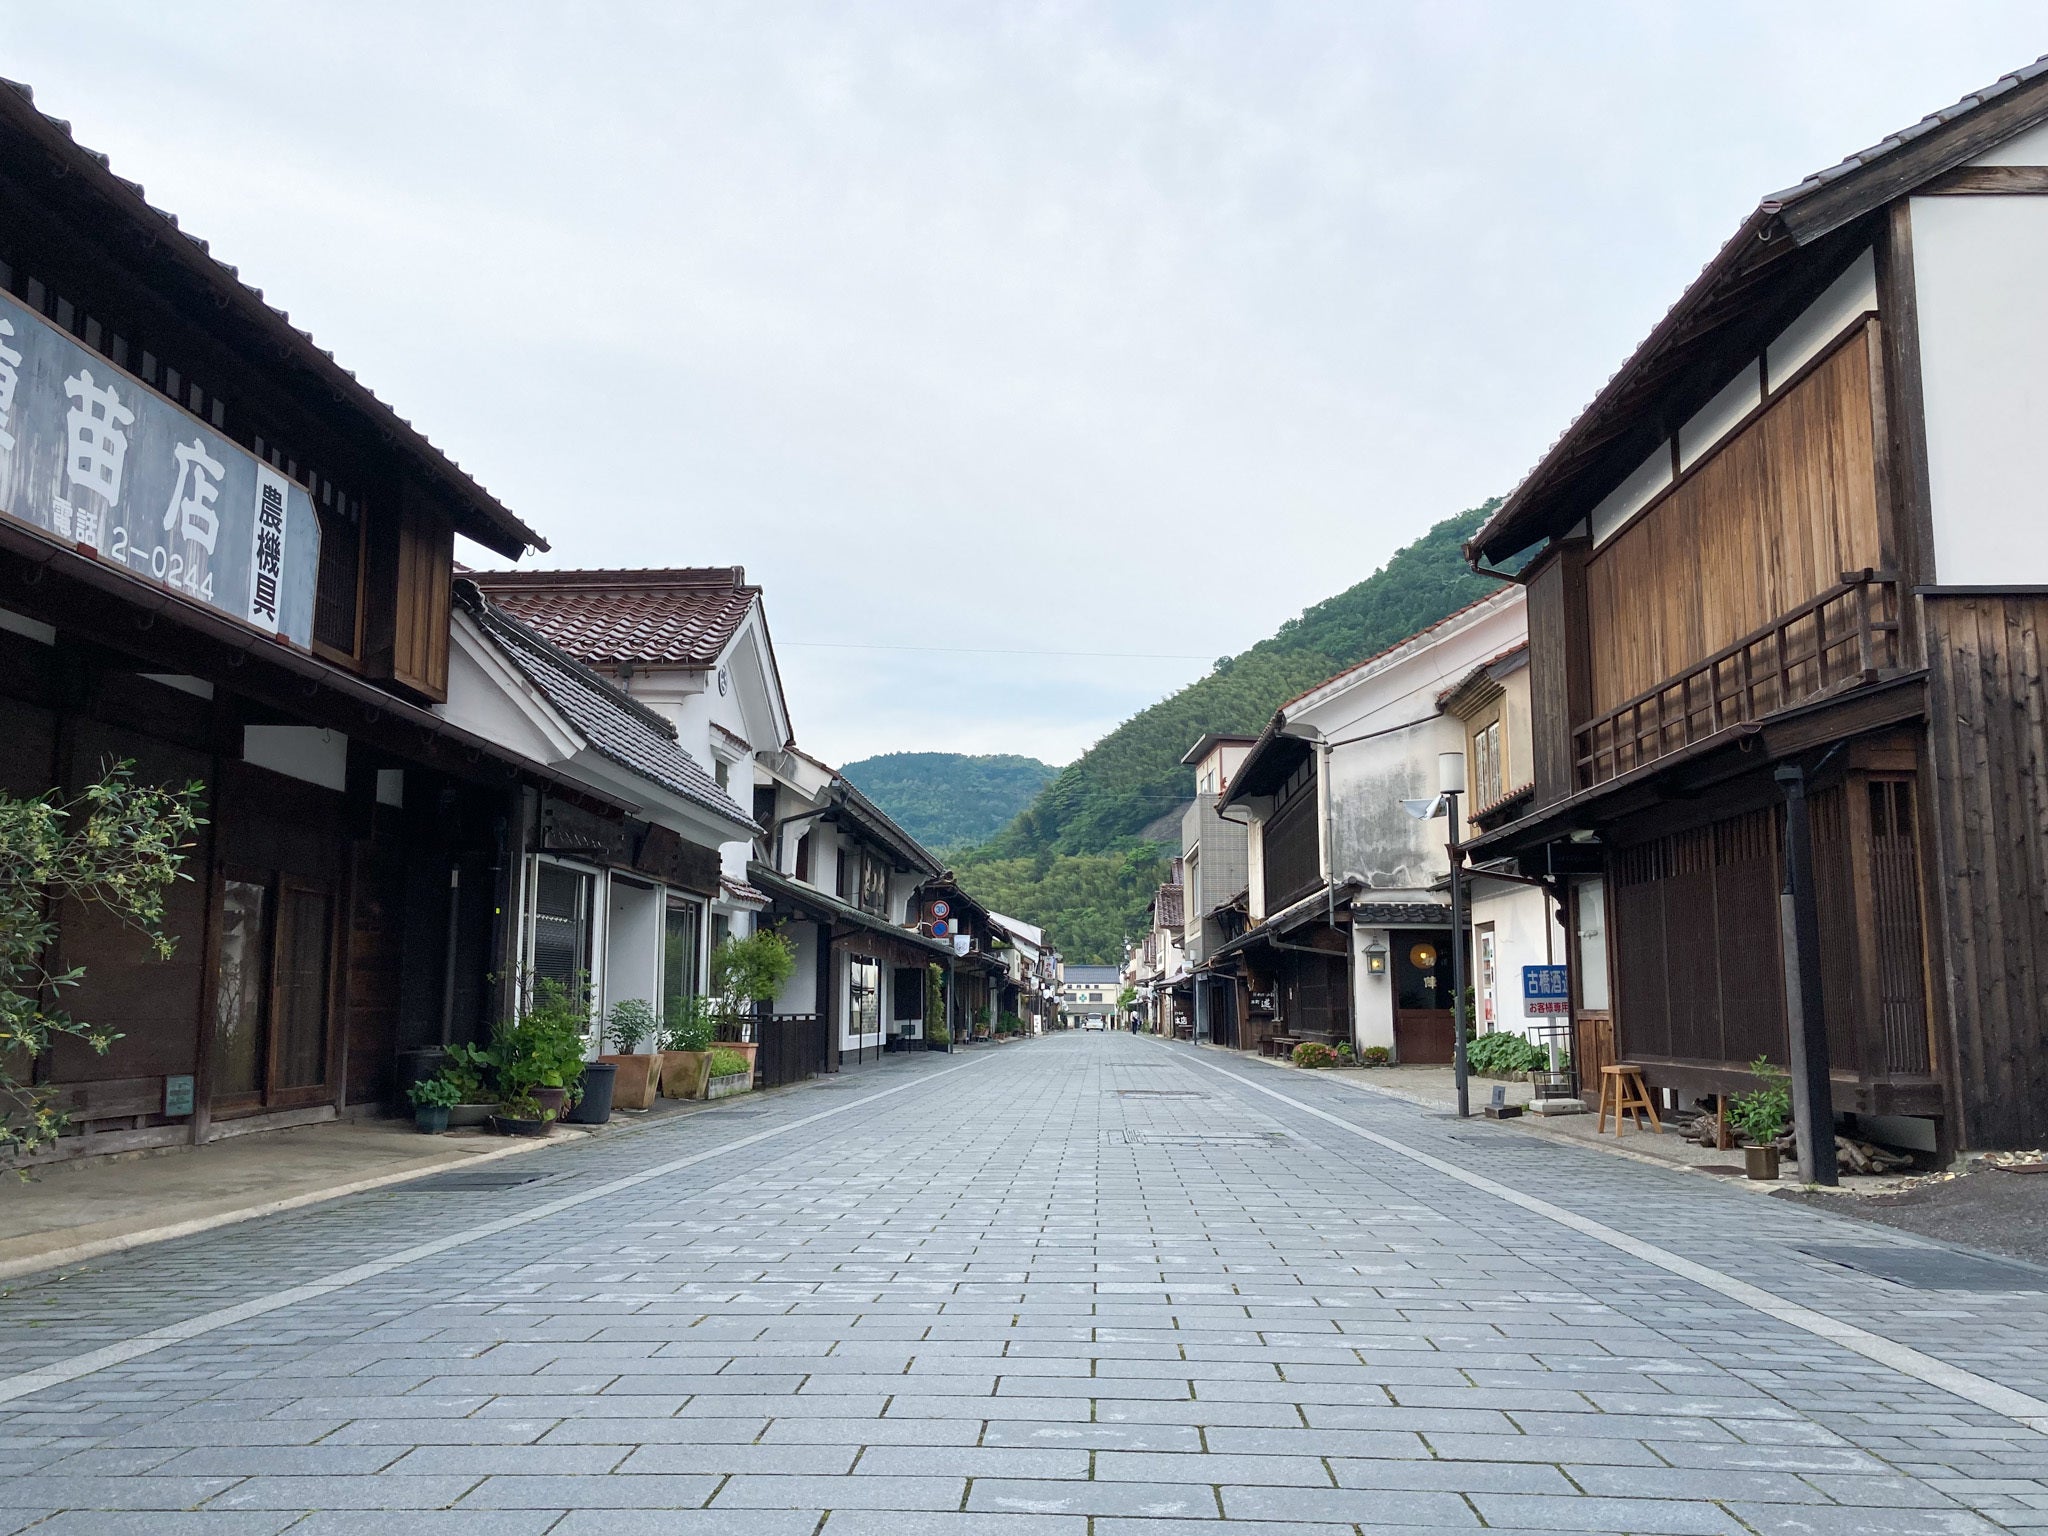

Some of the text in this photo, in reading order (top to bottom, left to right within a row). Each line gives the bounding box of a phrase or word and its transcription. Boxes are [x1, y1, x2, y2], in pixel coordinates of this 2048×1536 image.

[52, 495, 98, 546] 電話
[254, 484, 283, 623] 農機具
[935, 905, 946, 914] 30
